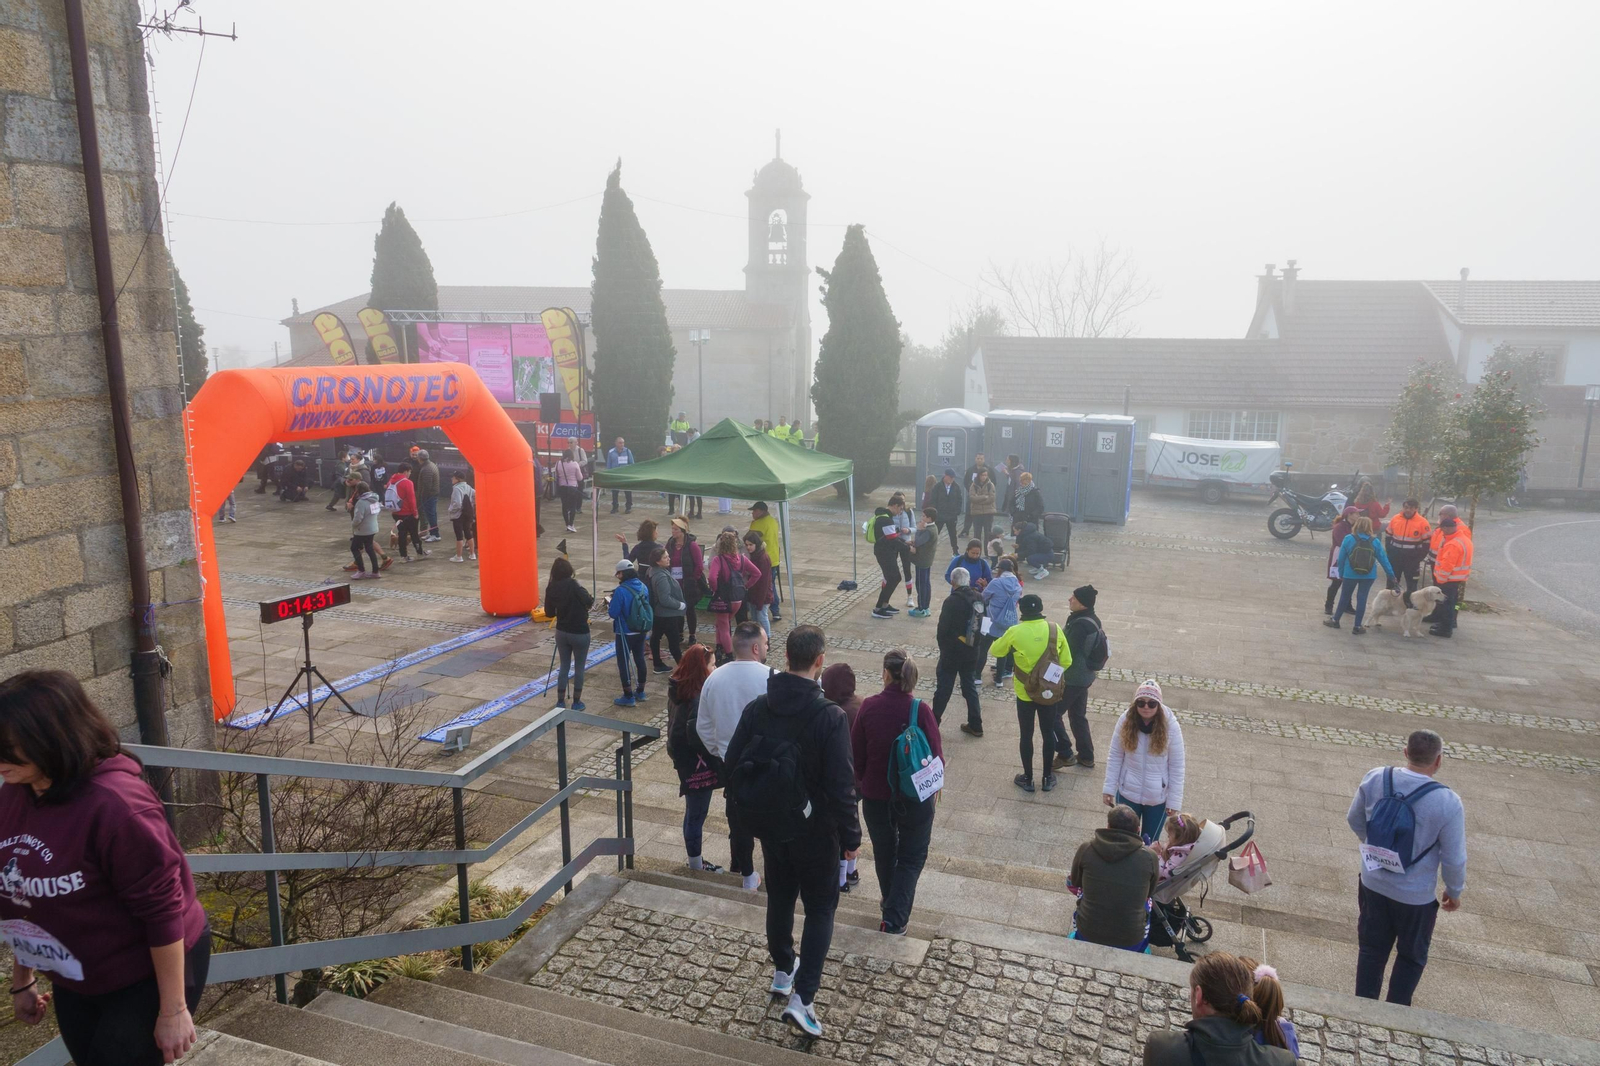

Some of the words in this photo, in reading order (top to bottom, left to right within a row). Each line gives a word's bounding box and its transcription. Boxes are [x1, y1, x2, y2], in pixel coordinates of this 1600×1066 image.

[292, 373, 459, 407] CRONOTEC
[289, 405, 459, 431] WWW.CRONOTEC.ES
[1177, 451, 1220, 466] JOSE
[277, 591, 334, 618] 0:14:31
[22, 870, 86, 898] MOUSE
